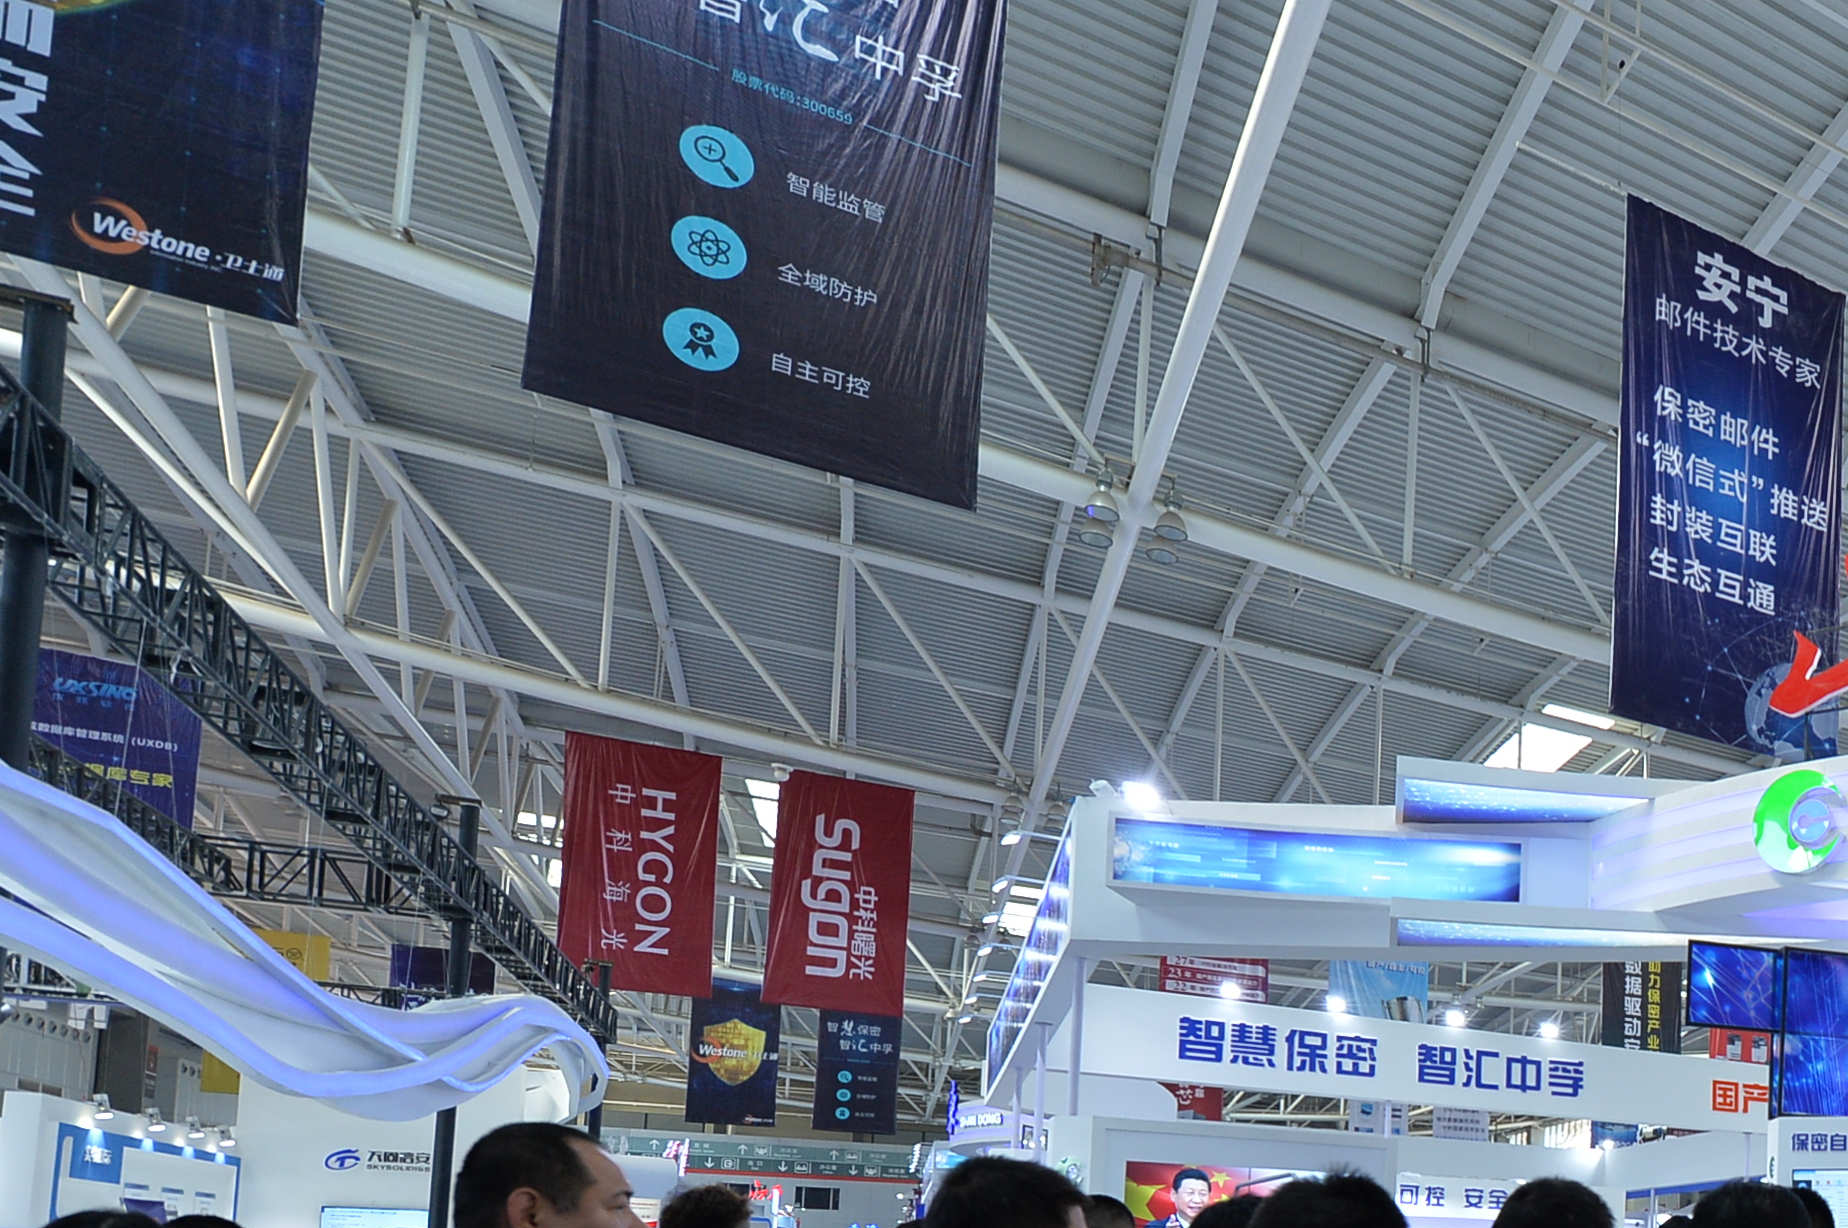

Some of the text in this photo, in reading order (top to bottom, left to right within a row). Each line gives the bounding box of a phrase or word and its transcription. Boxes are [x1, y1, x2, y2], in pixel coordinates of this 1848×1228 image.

[700, 0, 962, 101] 汇中孚
[731, 68, 854, 126] 股票代码:300659
[93, 211, 211, 263] Westone
[786, 171, 886, 225] 智能监管
[777, 262, 878, 308] 全域防护
[1693, 250, 1789, 329] 安宁
[769, 352, 871, 400] 自主可控
[1655, 292, 1823, 390] 邮件技术专家
[1653, 383, 1780, 462] 保密邮件
[1636, 430, 1829, 532] “微信式”推送
[1649, 493, 1777, 567] 封装互联
[1649, 548, 1776, 616] 生态互通
[600, 783, 637, 952] 中科海光
[632, 786, 677, 956] HYGON
[801, 813, 861, 979] Sugon
[848, 885, 880, 982] 中科曙光
[698, 1043, 748, 1060] Westone
[1178, 1016, 1585, 1098] 智慧保密 智汇中孚
[1400, 1184, 1508, 1209] 可控 安全
